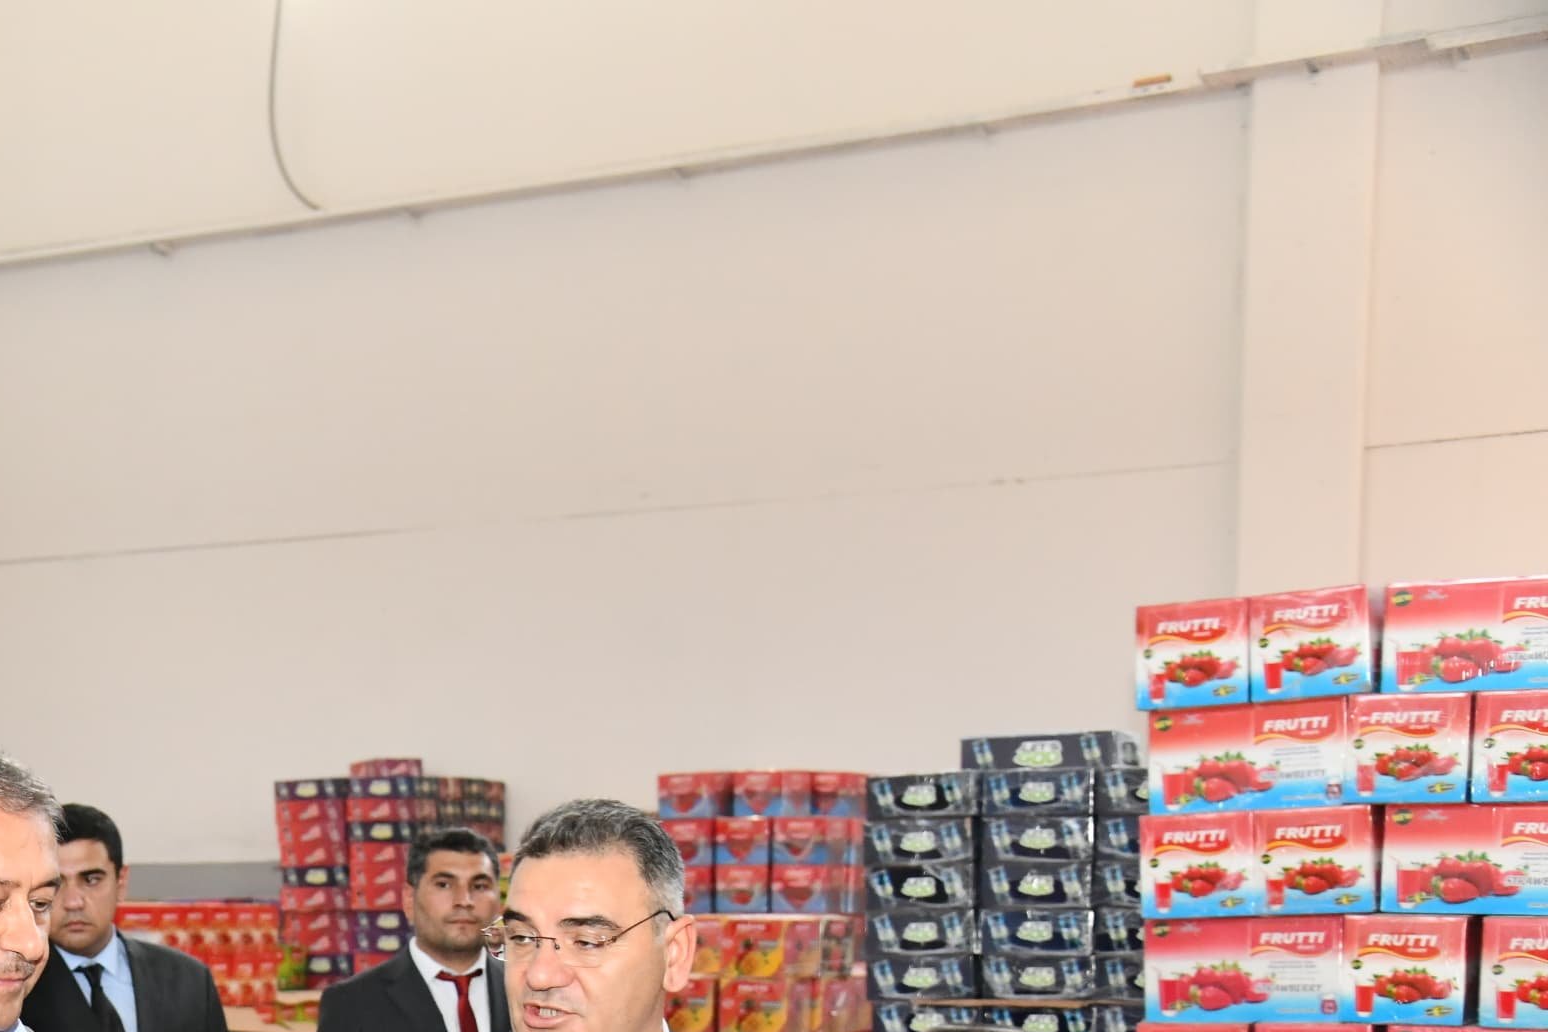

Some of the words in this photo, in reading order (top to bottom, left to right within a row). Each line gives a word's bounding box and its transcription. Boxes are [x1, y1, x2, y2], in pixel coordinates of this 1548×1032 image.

[1273, 603, 1339, 622] FRUTTI
[1156, 617, 1221, 634] FRUTTI
[1263, 715, 1329, 732] FRUTTI
[1369, 710, 1441, 724] FRUTTI
[1162, 829, 1227, 844] FRUTTI
[1275, 824, 1342, 839] FRUTTI
[1259, 931, 1325, 944] FRUTTI
[1367, 933, 1438, 946] FRUTTI
